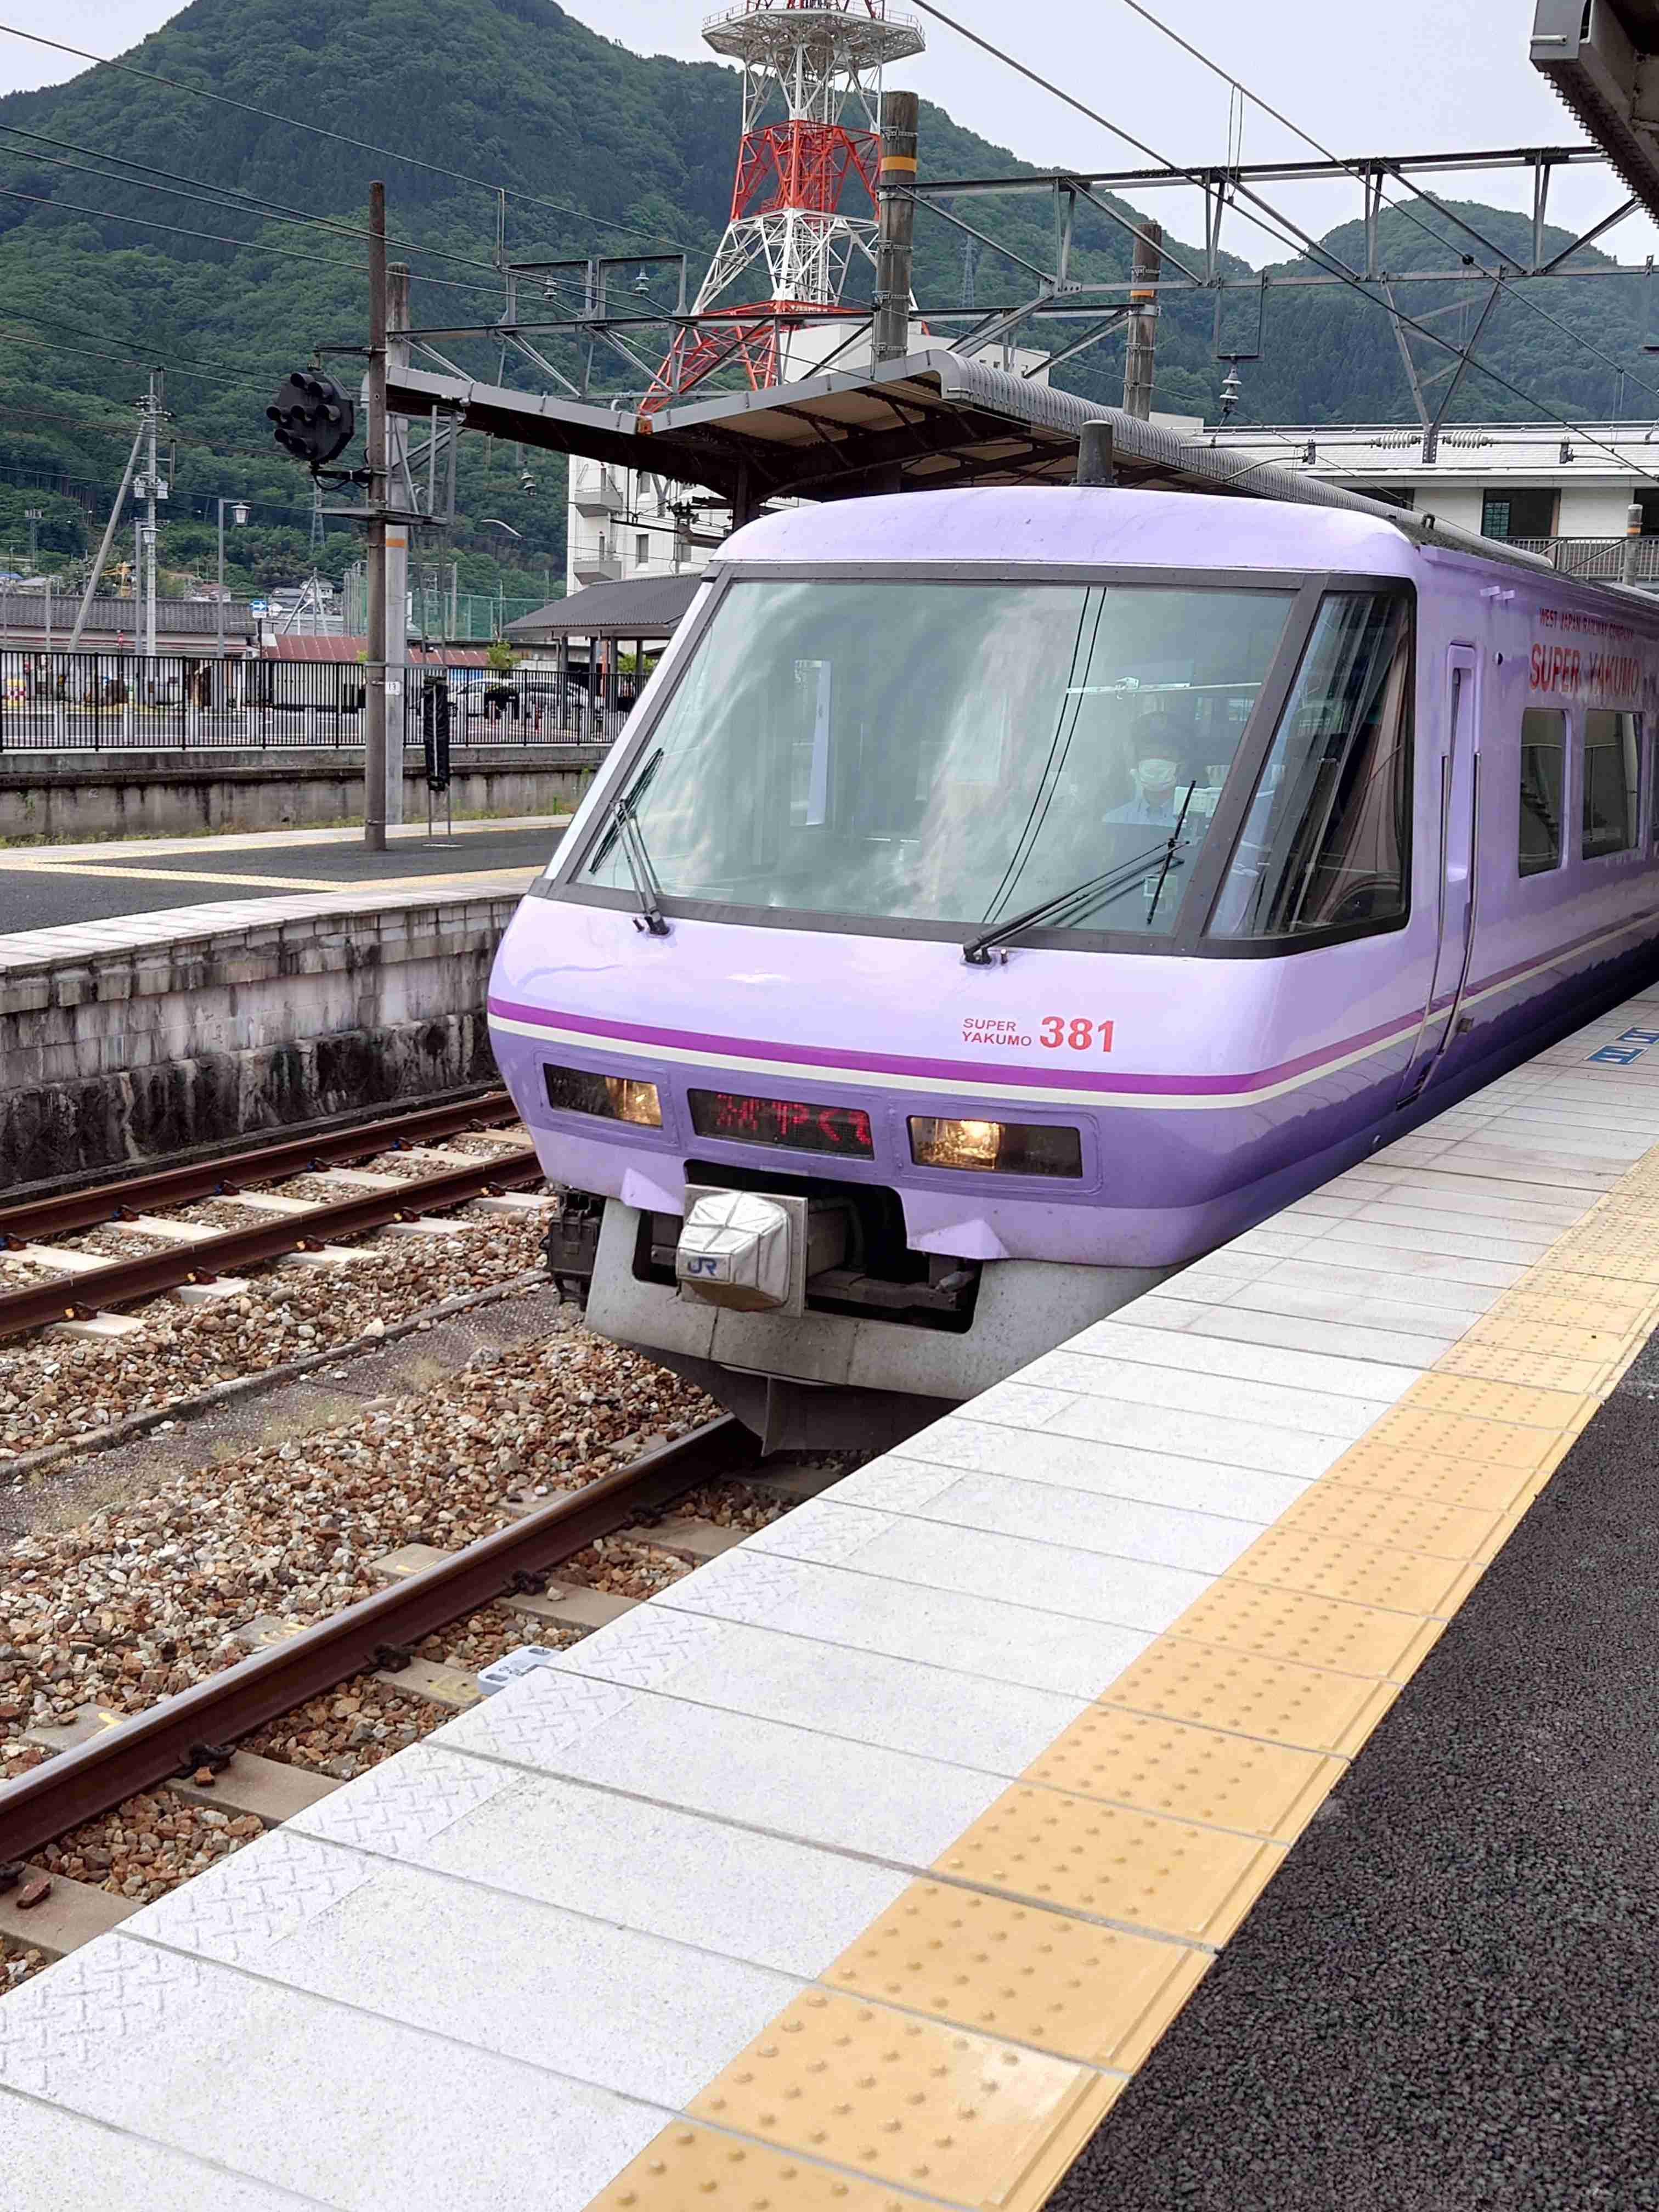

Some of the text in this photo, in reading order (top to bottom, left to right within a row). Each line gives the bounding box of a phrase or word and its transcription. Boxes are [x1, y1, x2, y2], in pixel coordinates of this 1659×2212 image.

[1540, 608, 1558, 628] WEST
[1561, 614, 1581, 633] JAPAN
[1530, 644, 1640, 697] SUPER YAKUMO
[963, 1018, 1016, 1031] SUPER
[1040, 1016, 1114, 1053] 381
[962, 1031, 1032, 1046] YAKUMO
[688, 1256, 717, 1276] JR
